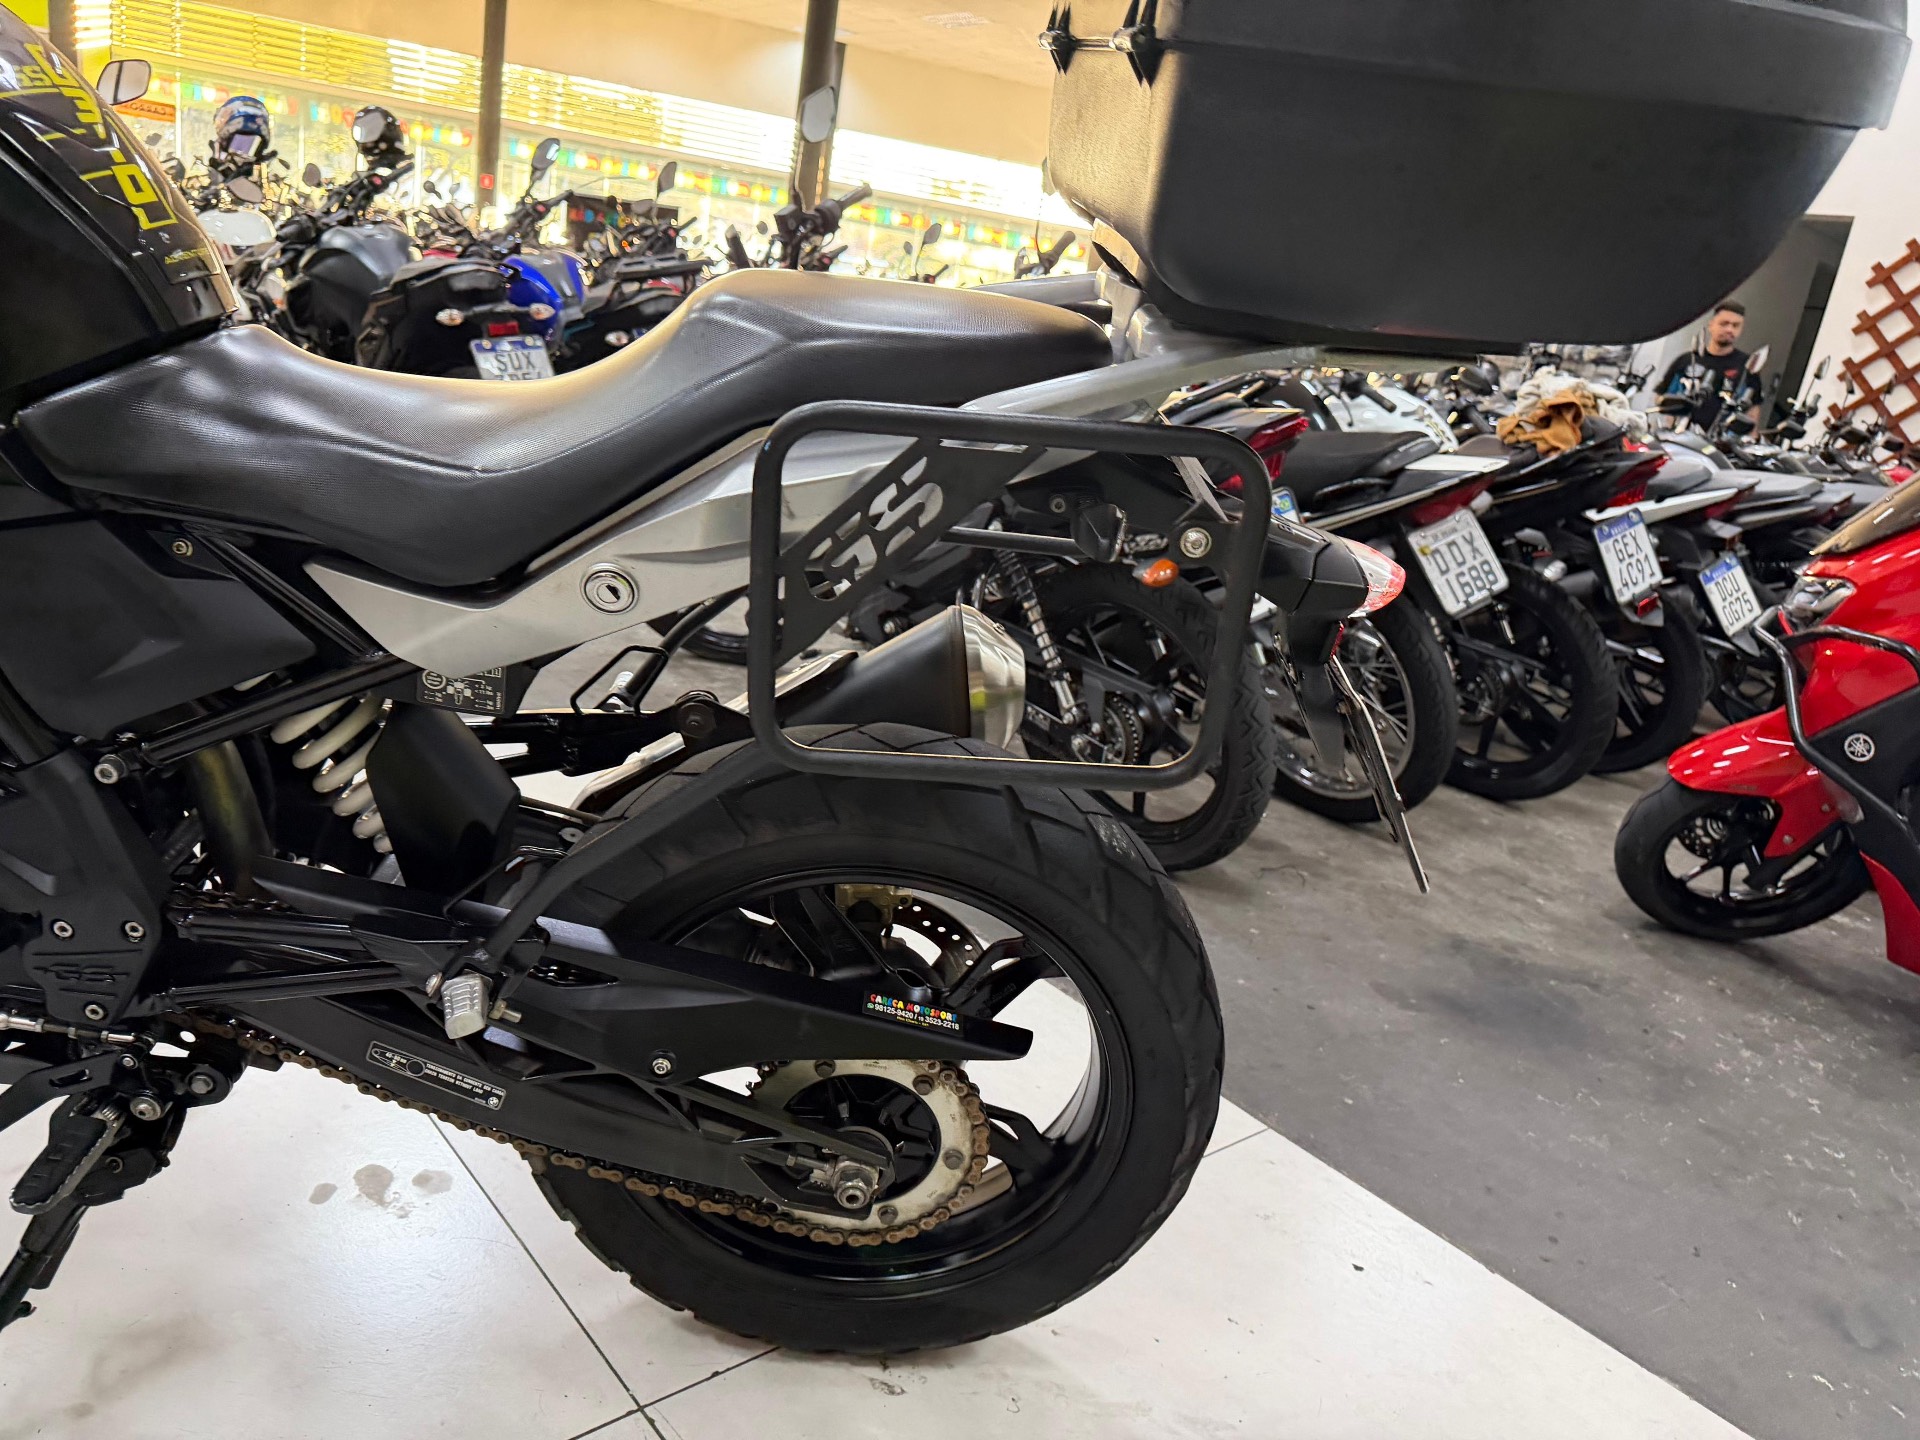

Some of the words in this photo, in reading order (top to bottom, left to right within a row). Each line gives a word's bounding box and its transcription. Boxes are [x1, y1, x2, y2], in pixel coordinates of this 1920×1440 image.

[495, 351, 535, 372] SUX
[1431, 531, 1484, 576] DDX
[1612, 530, 1643, 564] GEX
[1445, 560, 1499, 604] 1688
[1619, 554, 1656, 591] 4C91
[1714, 572, 1741, 602] DCU
